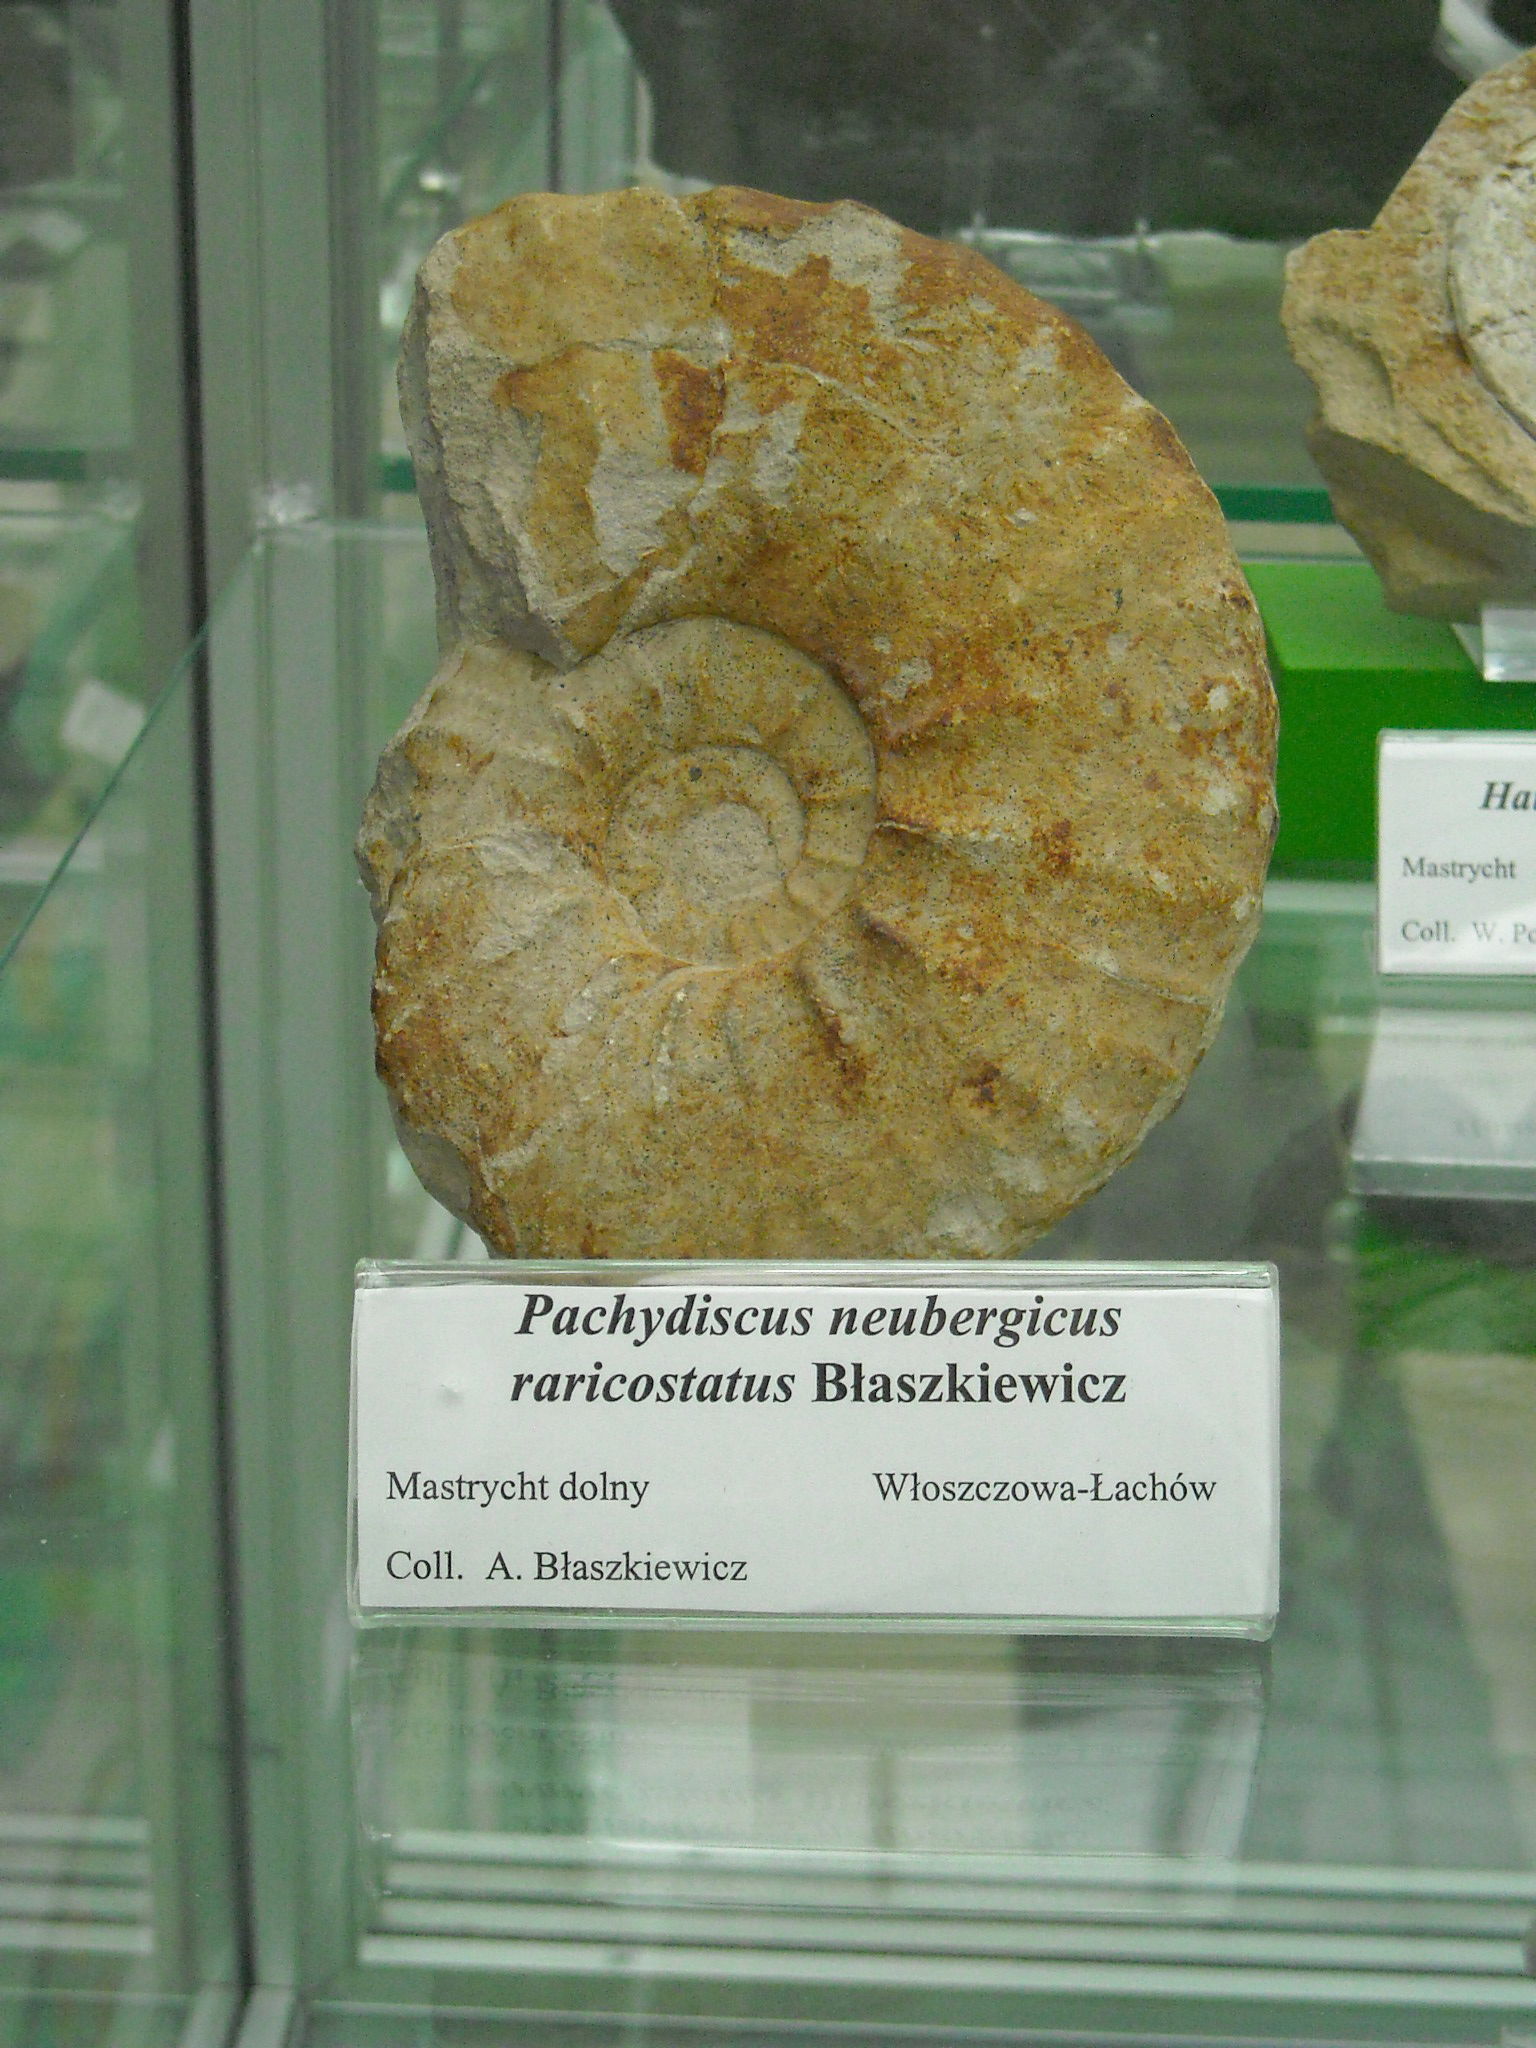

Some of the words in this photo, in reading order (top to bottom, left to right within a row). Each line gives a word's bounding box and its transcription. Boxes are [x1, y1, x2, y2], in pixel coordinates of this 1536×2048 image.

[1478, 780, 1536, 811] Ha
[1402, 855, 1517, 884] Mastrycht
[1400, 919, 1455, 943] Coll.
[1472, 920, 1504, 944] W.
[513, 1293, 814, 1348] Pachydiscus
[828, 1294, 1122, 1349] neubergicus
[510, 1361, 796, 1403] raricostatus
[811, 1362, 1127, 1404] Błaszkiewicz
[386, 1471, 550, 1508] Mastrycht
[559, 1471, 650, 1508] dolny
[872, 1471, 1217, 1502] Włoszczowa-Łachów
[386, 1550, 463, 1580] Coll.
[485, 1551, 522, 1581] A.
[533, 1550, 748, 1581] Błaszkiewicz
